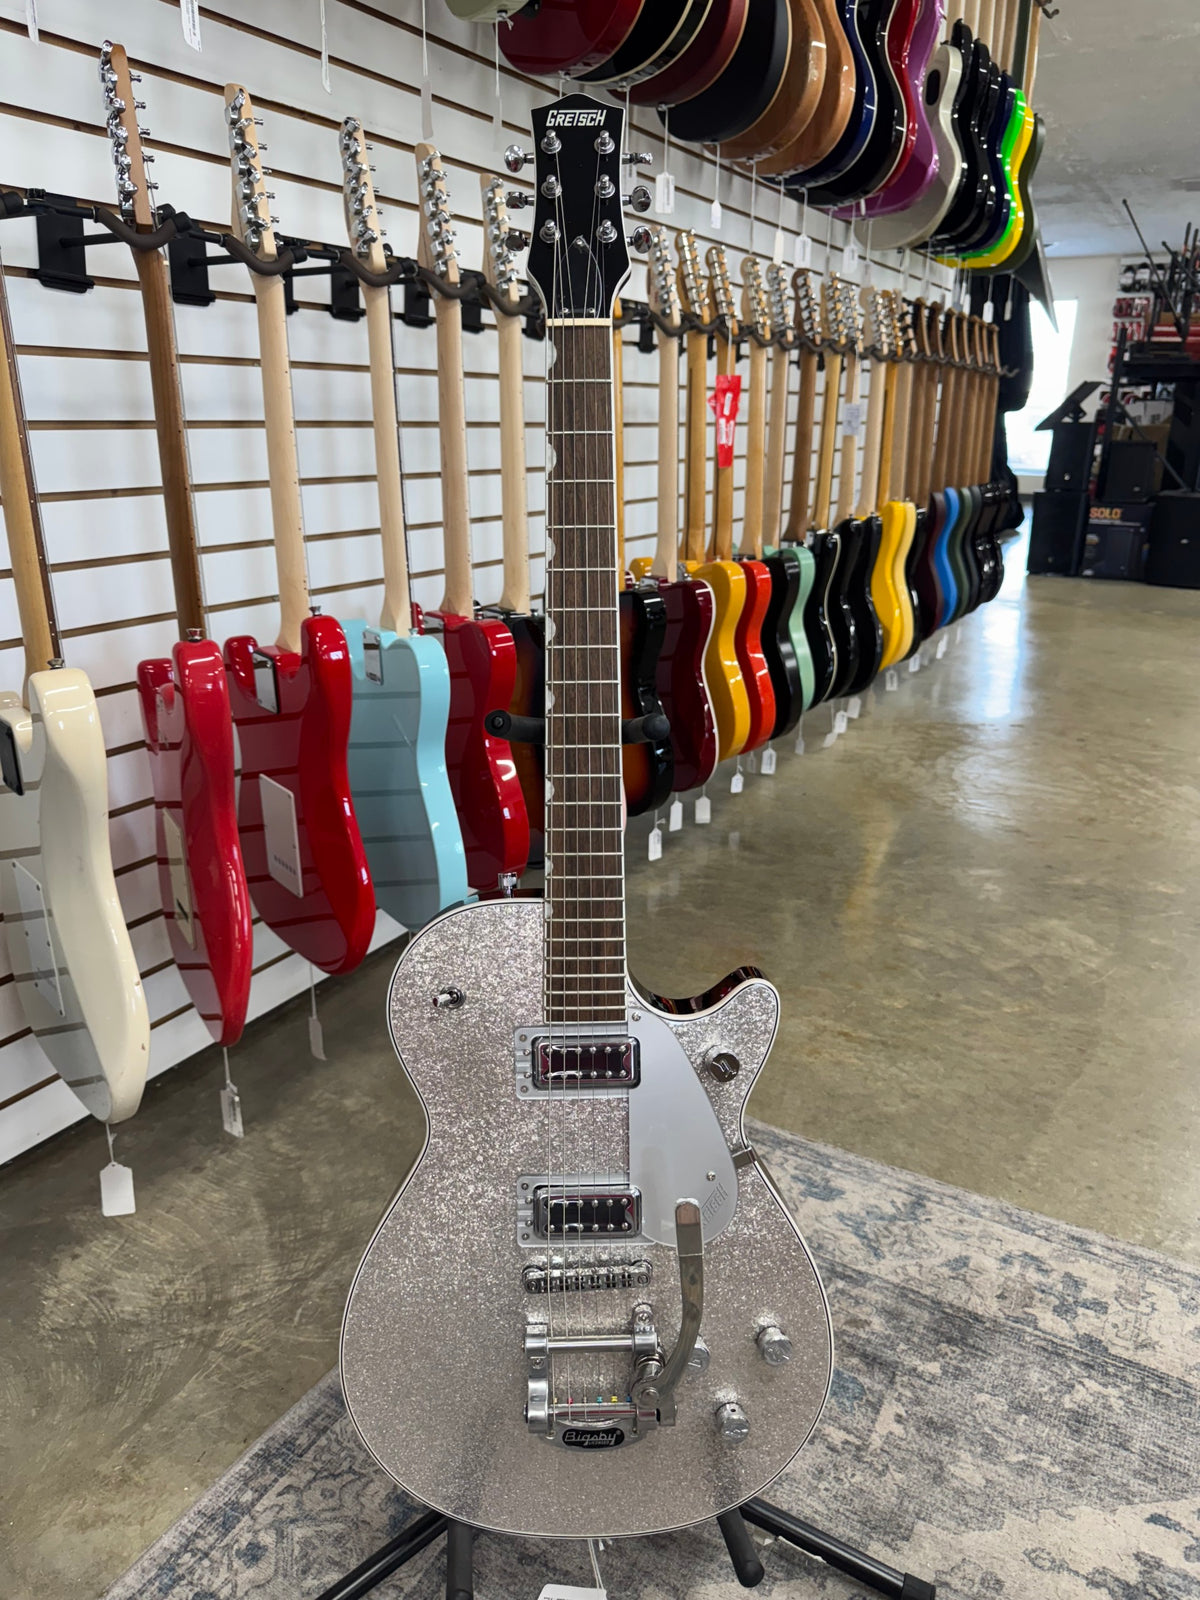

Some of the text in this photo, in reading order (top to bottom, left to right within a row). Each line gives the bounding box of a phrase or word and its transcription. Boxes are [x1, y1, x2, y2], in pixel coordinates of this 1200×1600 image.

[546, 109, 606, 127] GRETSCH
[1089, 506, 1122, 518] SOLO
[564, 1430, 617, 1446] Bigsby
